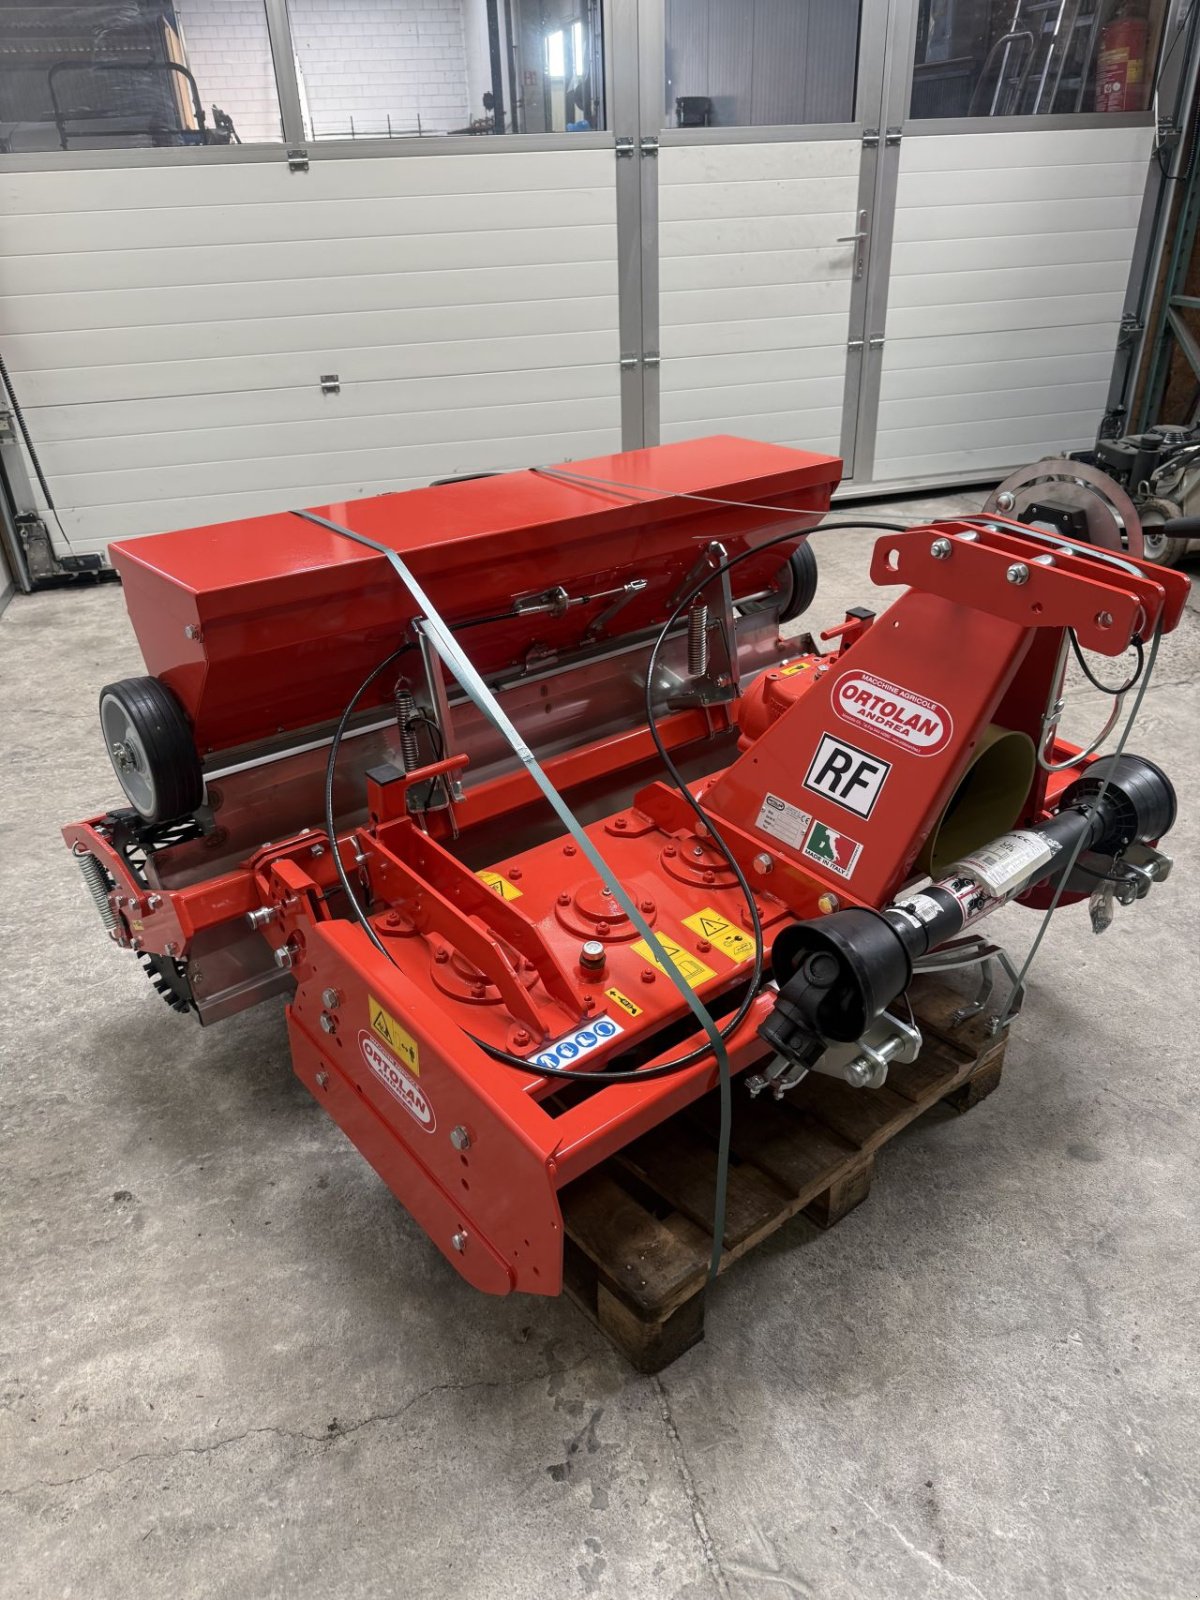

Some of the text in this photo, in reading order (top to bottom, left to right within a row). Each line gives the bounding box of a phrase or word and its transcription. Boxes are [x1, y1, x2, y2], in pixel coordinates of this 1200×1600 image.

[842, 684, 940, 737] ORTOLAN
[861, 674, 937, 711] MACCHINE AGRICOLE
[857, 708, 911, 737] ANDREA
[813, 747, 880, 799] RF
[805, 849, 822, 862] MADE
[829, 862, 846, 874] ITALY
[364, 1042, 426, 1114] ORTOLAN
[378, 1068, 413, 1108] ANDREA
